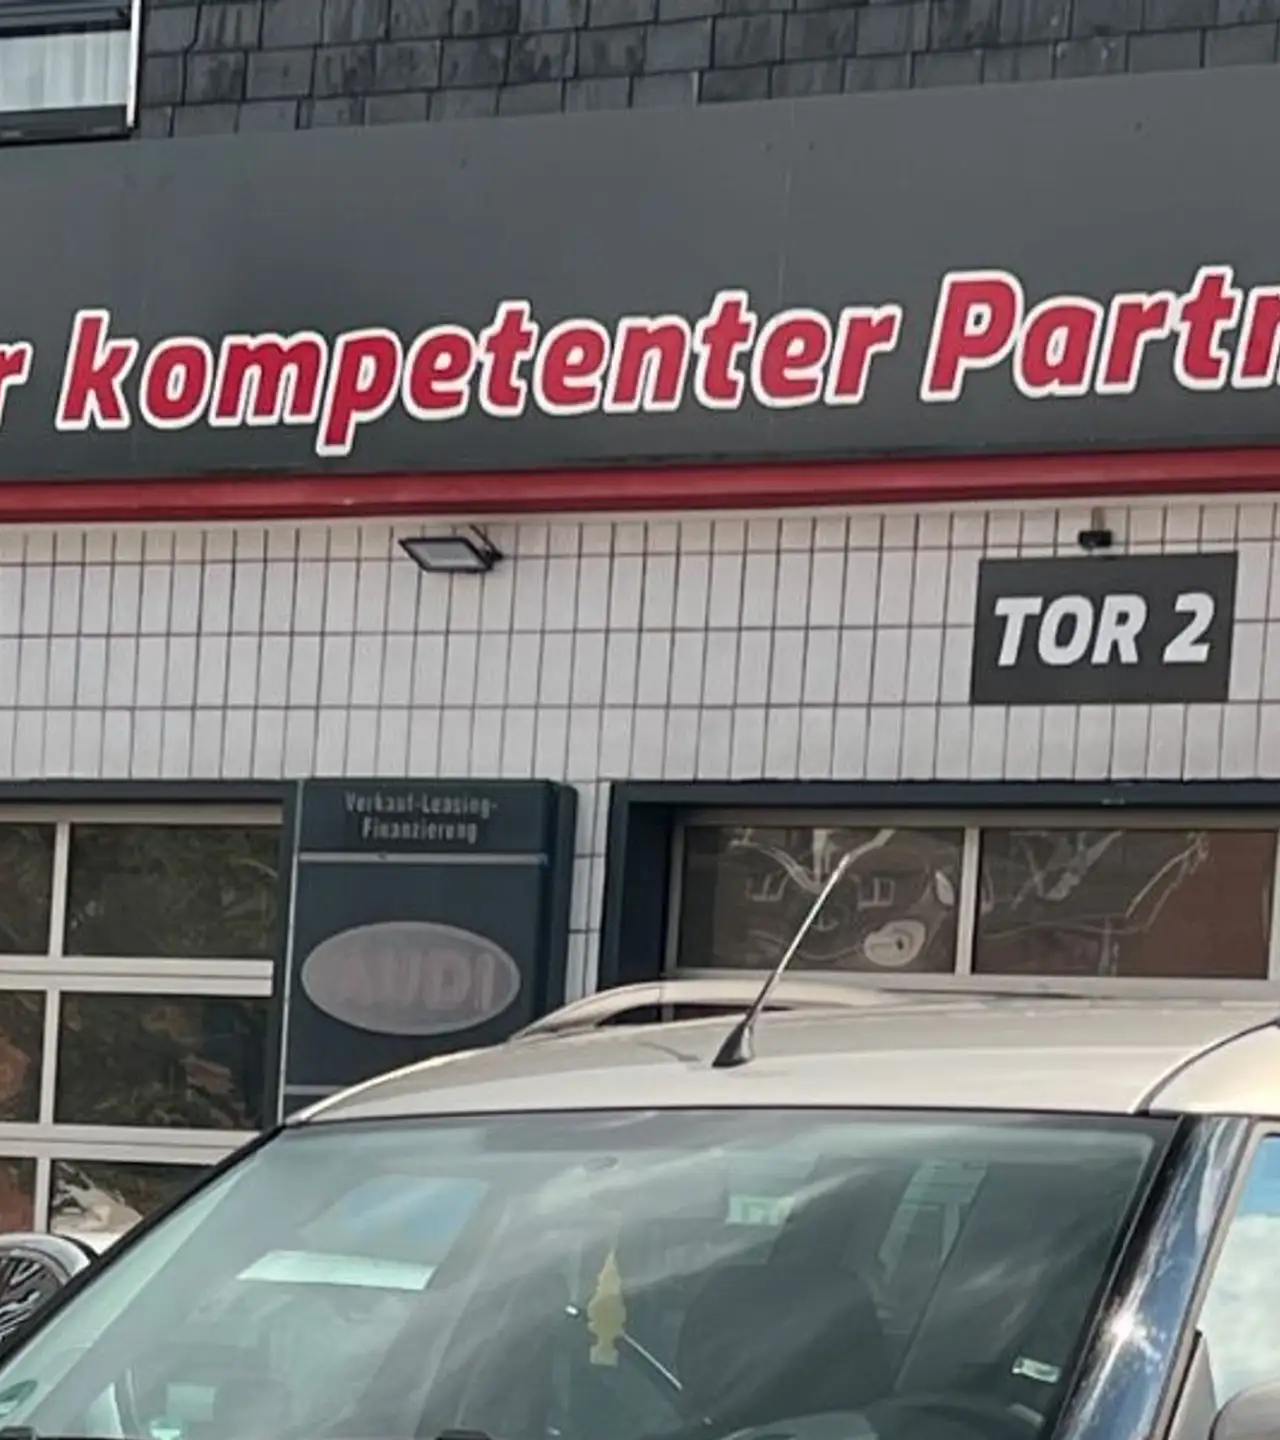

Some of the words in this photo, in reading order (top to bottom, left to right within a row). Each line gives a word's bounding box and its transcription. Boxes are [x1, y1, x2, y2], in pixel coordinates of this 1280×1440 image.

[56, 289, 901, 455] kompetenter
[993, 595, 1147, 667] TOR
[1163, 593, 1216, 663] 2
[361, 816, 478, 843] Finanzierung
